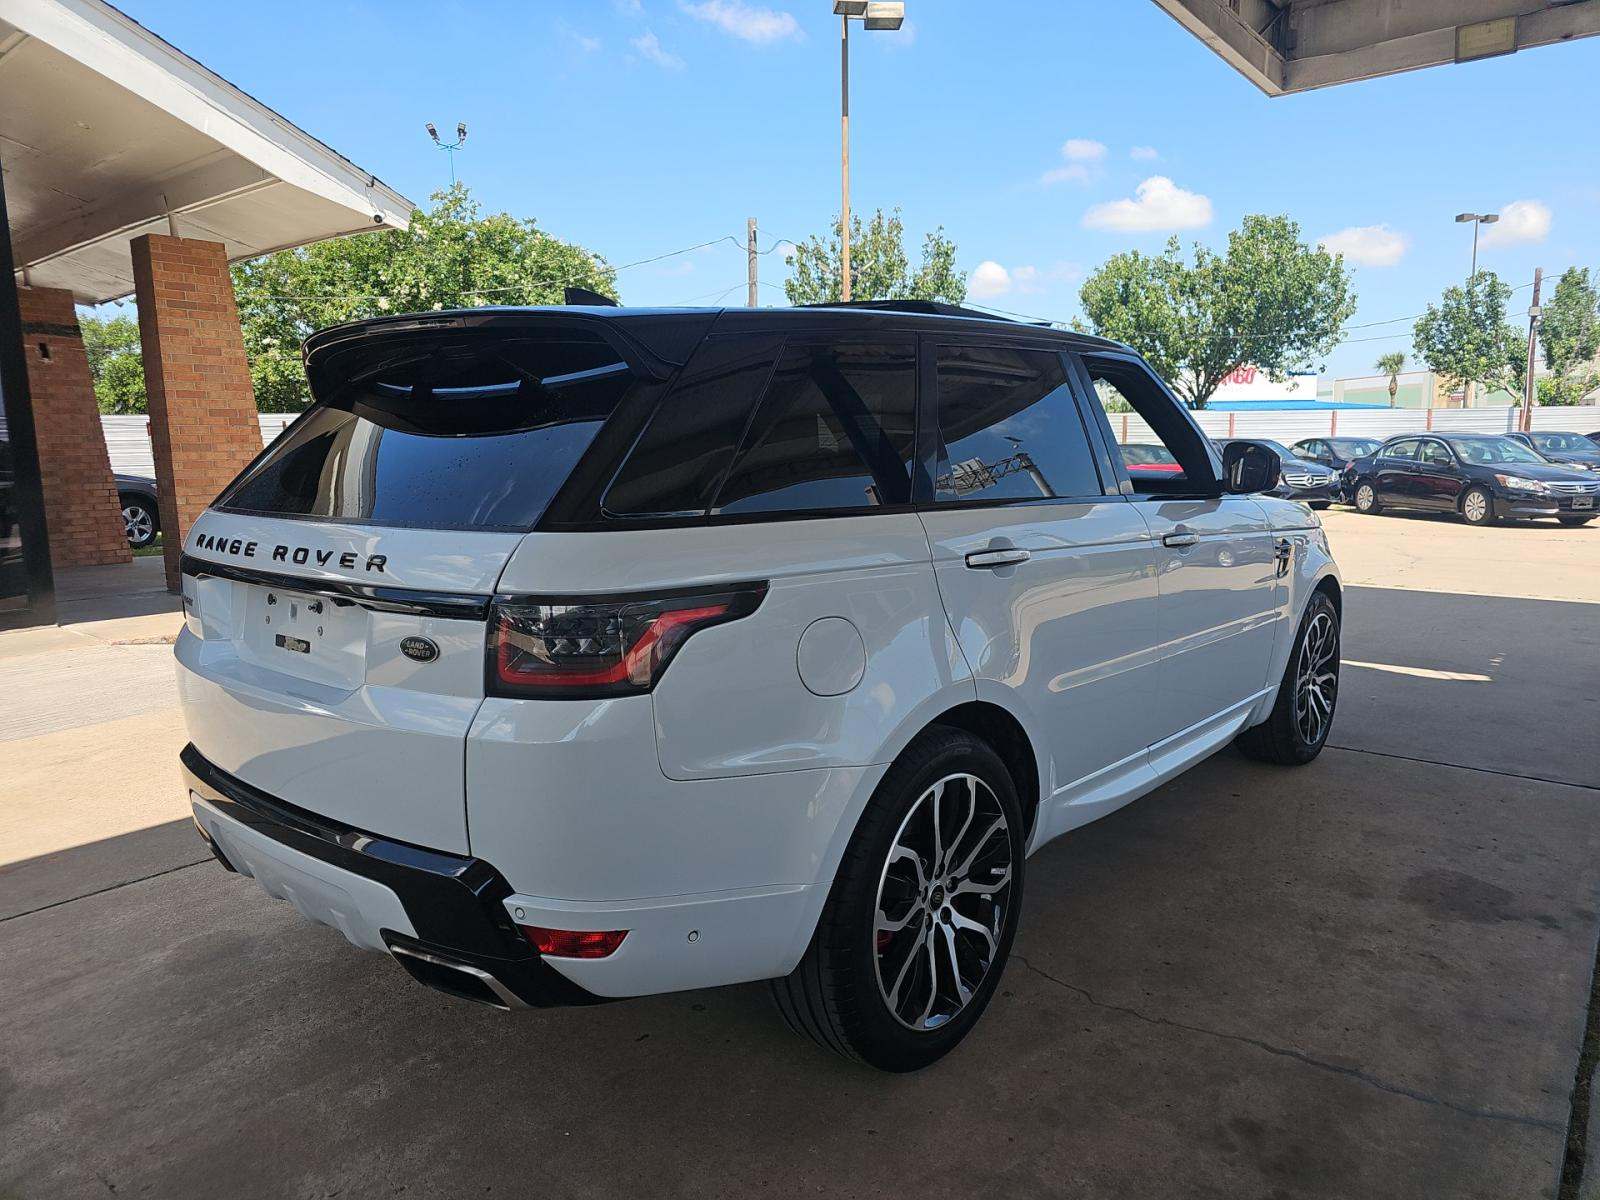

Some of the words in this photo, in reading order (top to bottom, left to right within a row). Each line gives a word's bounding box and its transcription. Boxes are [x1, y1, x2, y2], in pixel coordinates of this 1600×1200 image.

[196, 534, 258, 557] RANGE
[272, 545, 387, 572] ROVER
[406, 640, 425, 650] LAND
[408, 648, 431, 657] ROVER
